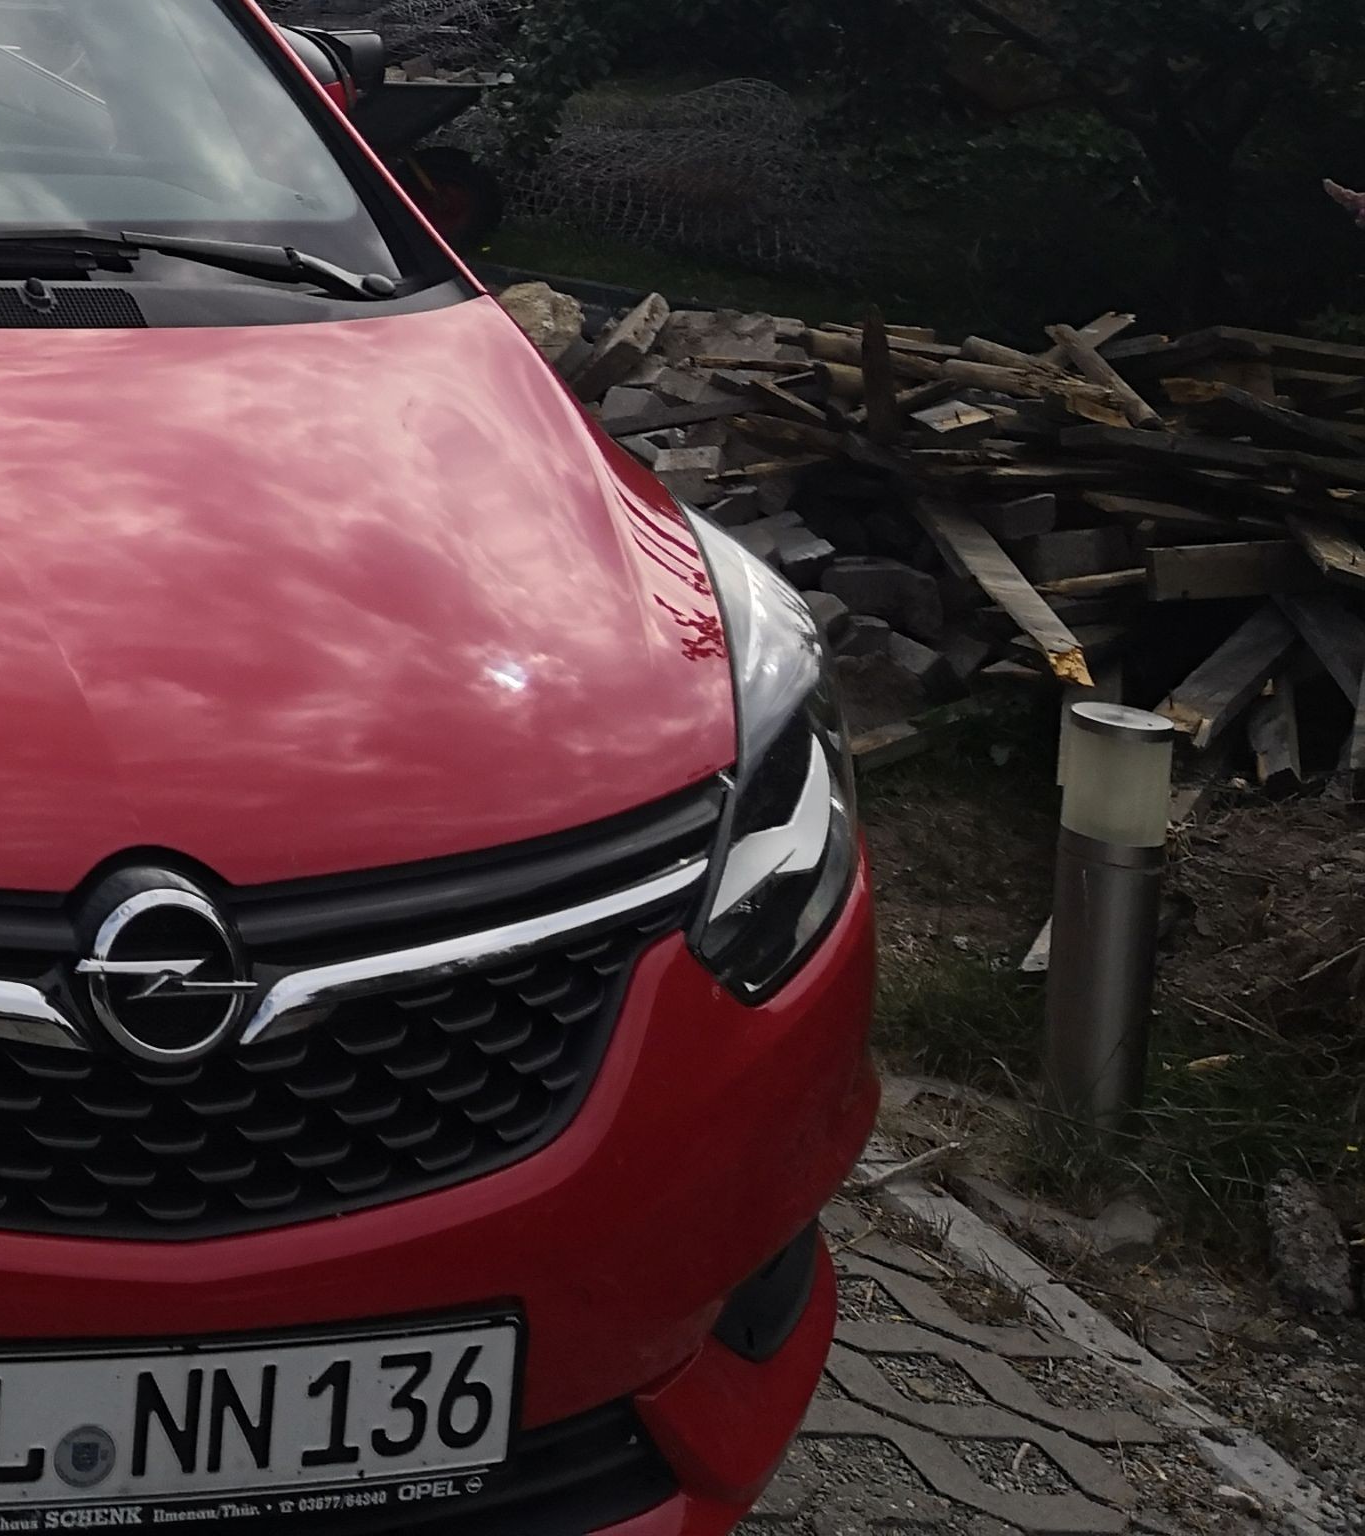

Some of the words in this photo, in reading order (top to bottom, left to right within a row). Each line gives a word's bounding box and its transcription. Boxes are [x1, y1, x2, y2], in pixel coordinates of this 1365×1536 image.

[131, 1364, 278, 1477] NN
[300, 1345, 494, 1468] 136
[44, 1506, 144, 1529] SCHENK
[397, 1479, 461, 1502] OPEL
